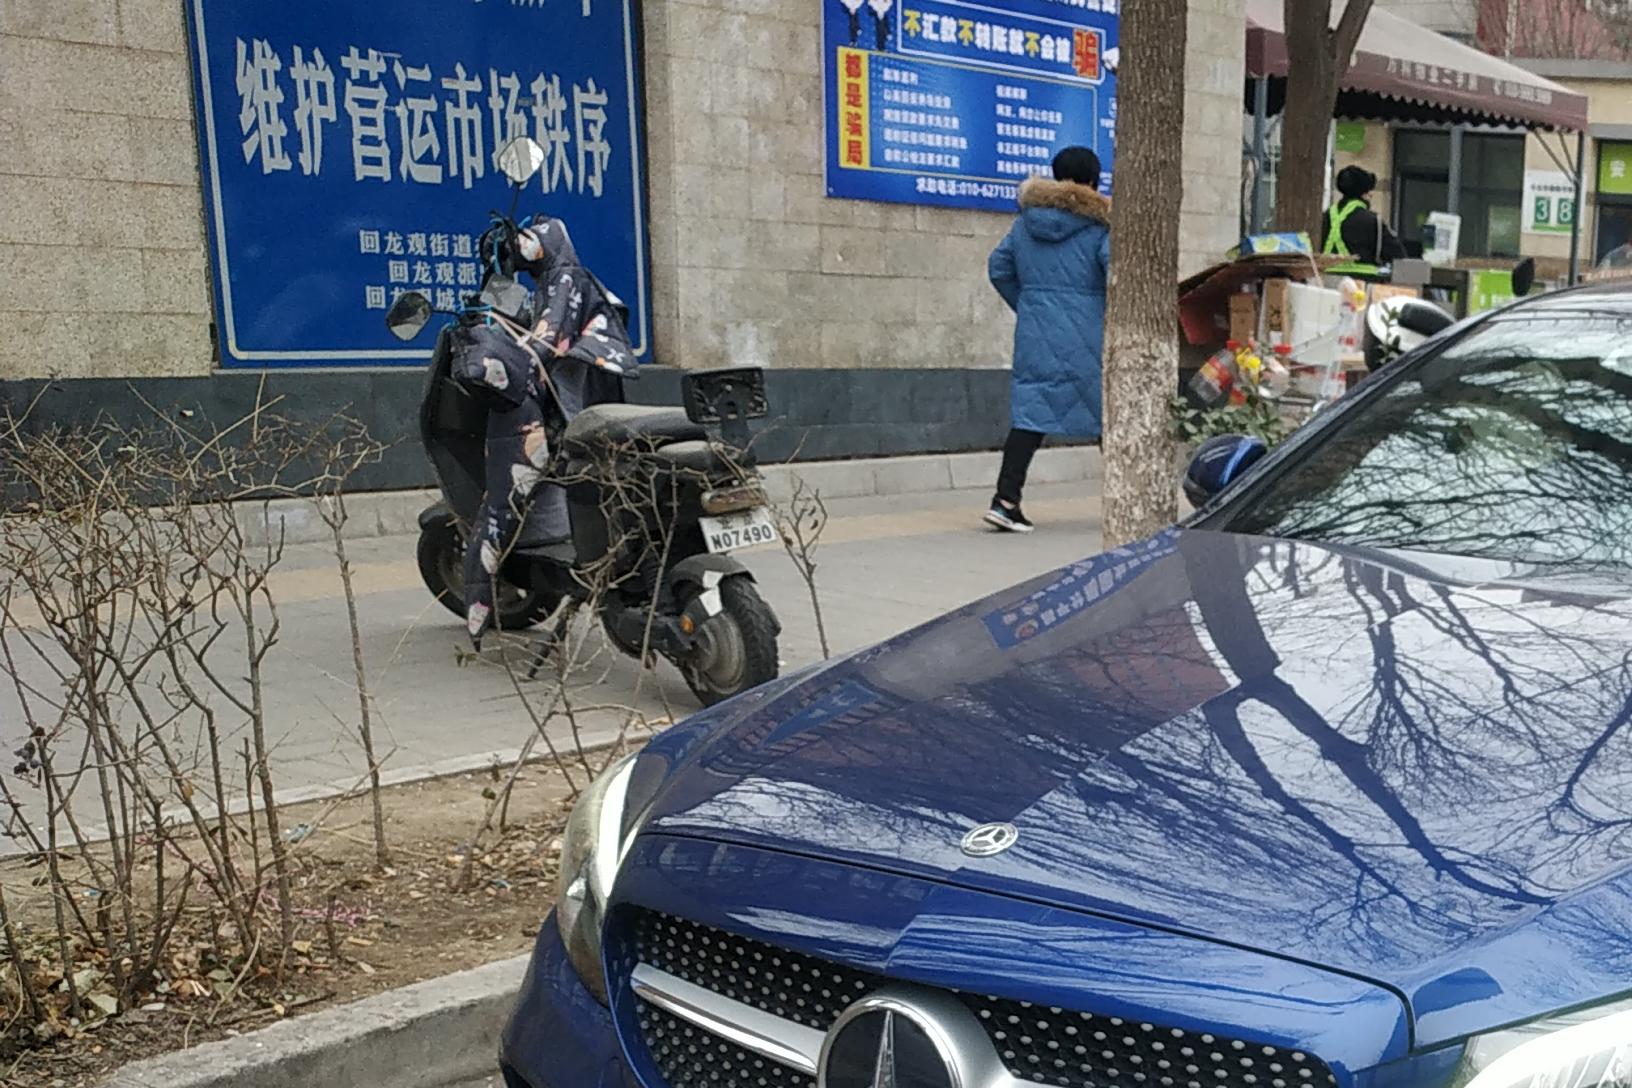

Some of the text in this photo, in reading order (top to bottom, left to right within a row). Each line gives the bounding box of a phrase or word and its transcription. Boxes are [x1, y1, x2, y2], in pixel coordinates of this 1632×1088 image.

[235, 36, 611, 197] 维护营运市场秩序
[845, 53, 863, 165] 都是骗局
